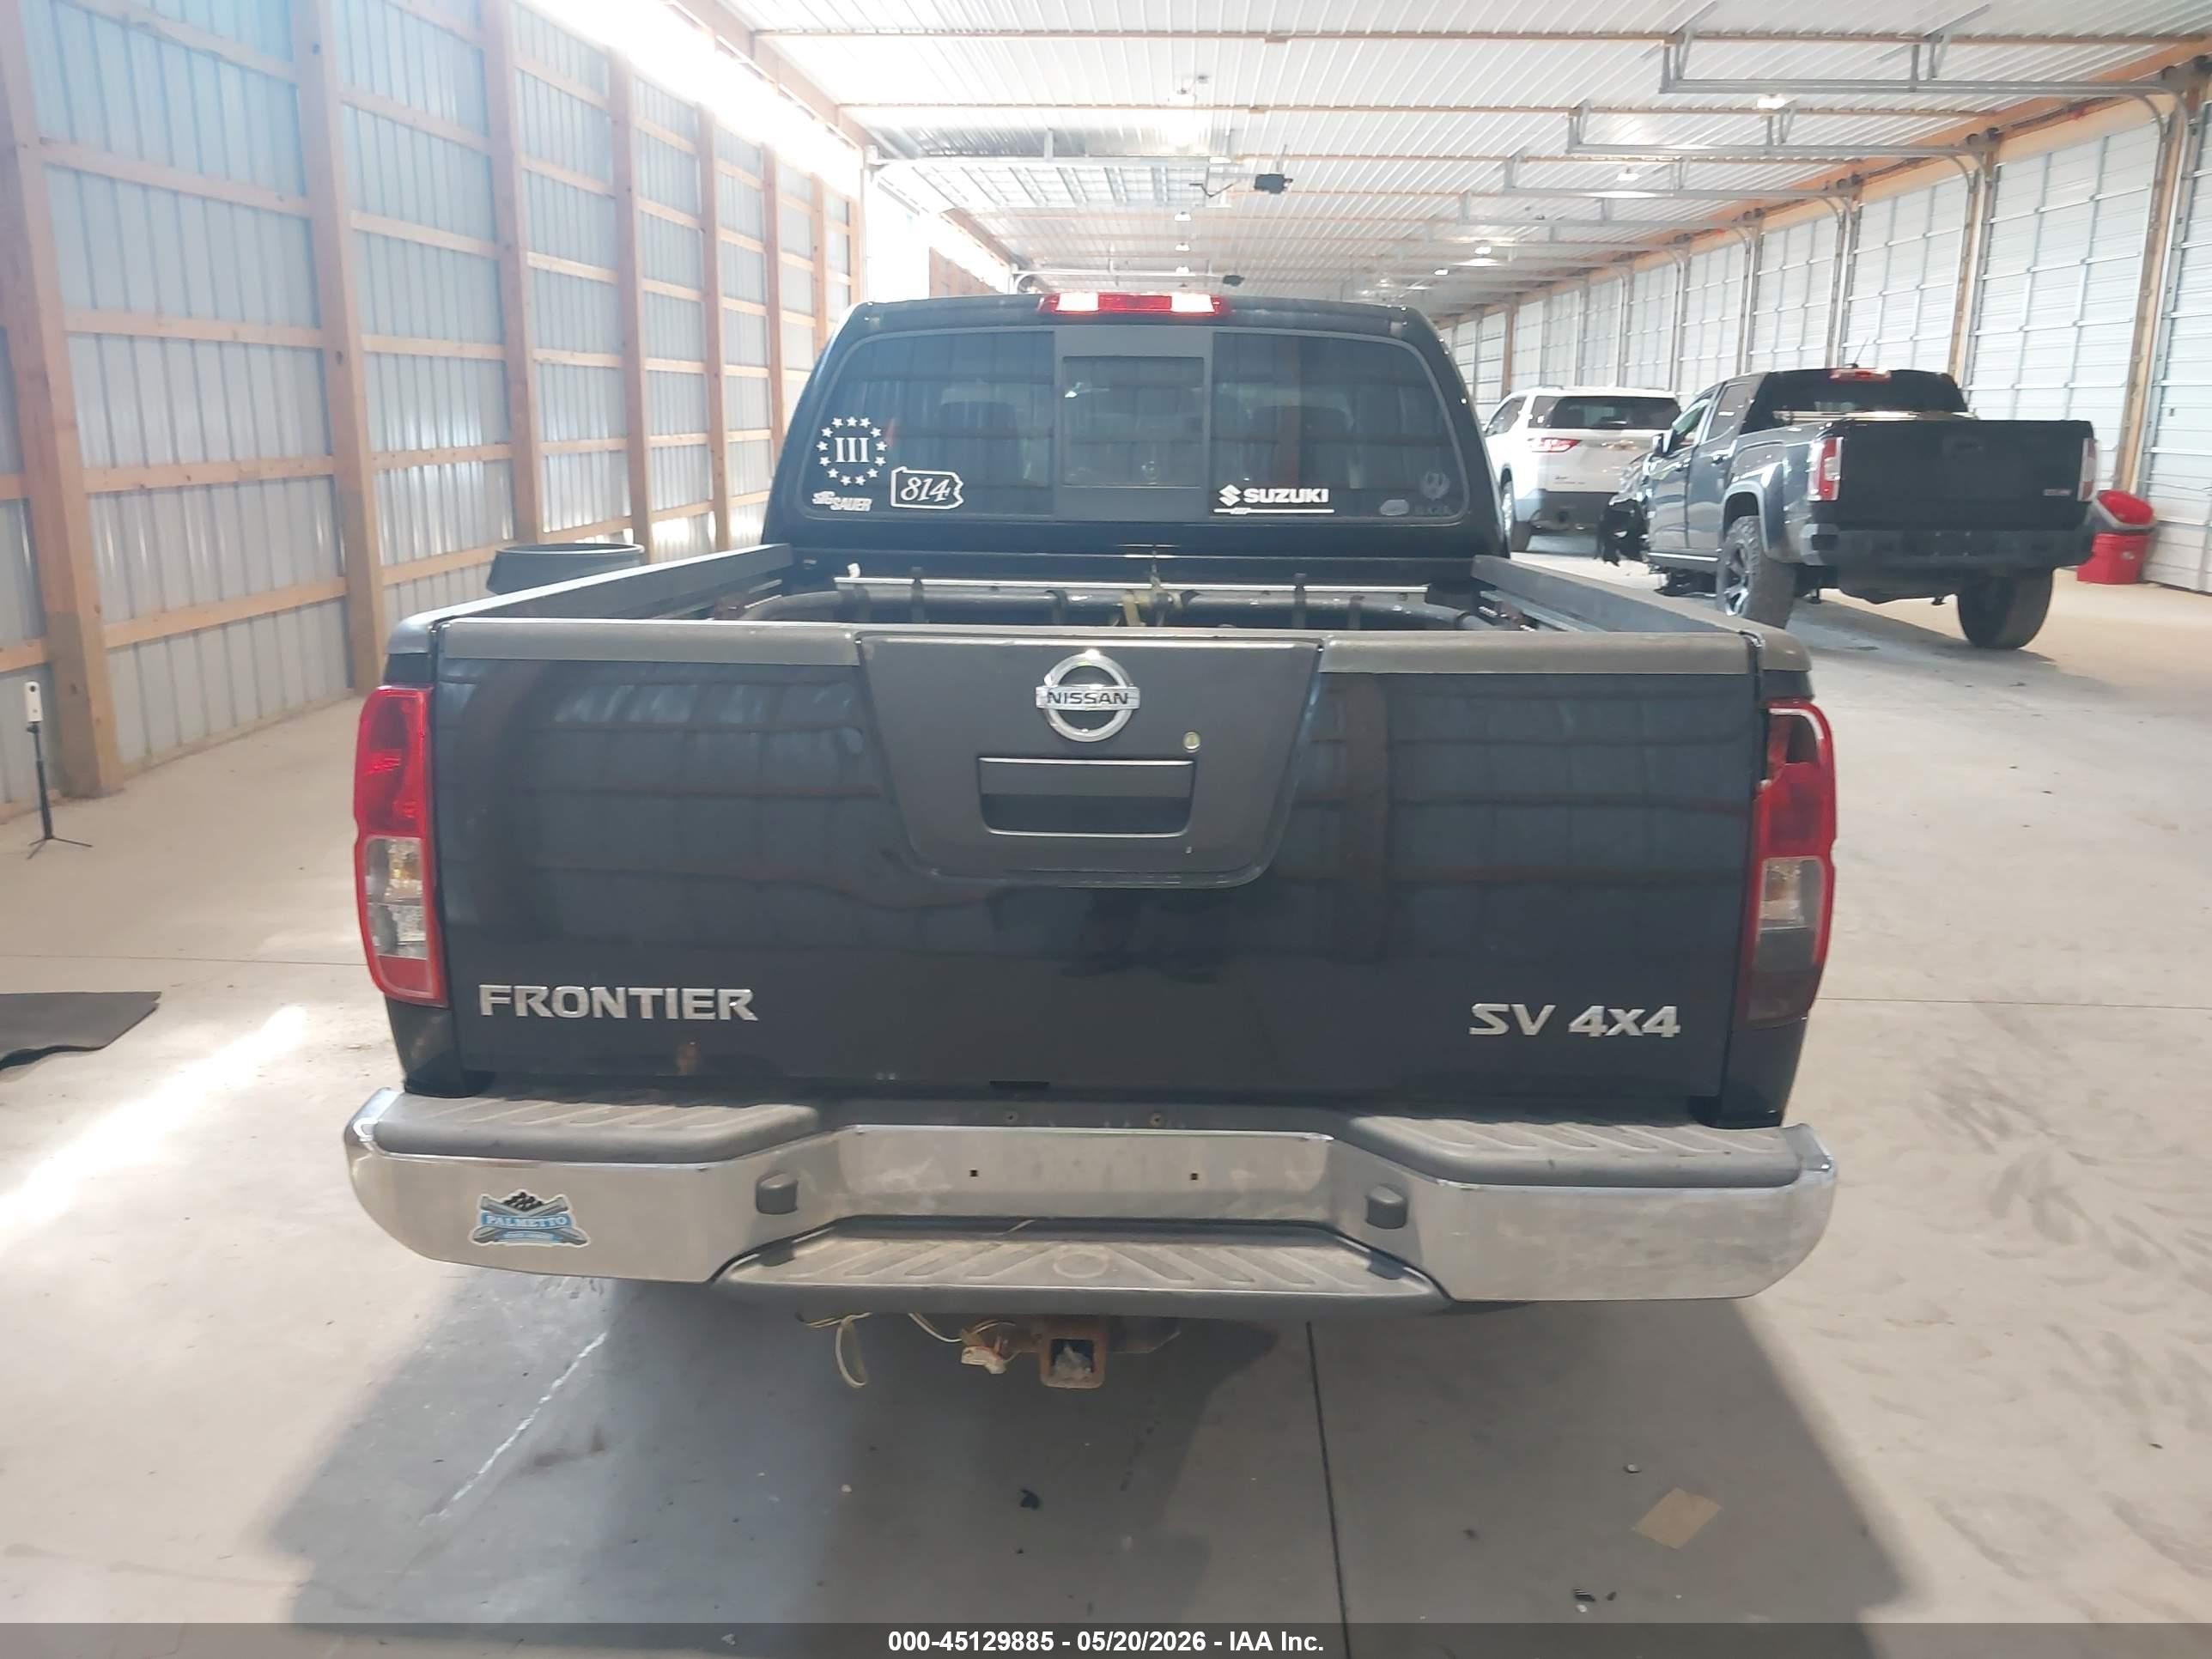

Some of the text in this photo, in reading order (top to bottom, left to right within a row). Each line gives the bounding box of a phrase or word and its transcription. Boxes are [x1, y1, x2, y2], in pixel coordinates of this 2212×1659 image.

[834, 437, 870, 463] III
[900, 477, 951, 502] 814
[1244, 488, 1330, 503] SUZUKI
[1047, 691, 1129, 705] NISSAN
[478, 984, 759, 1022] FRONTIER
[1469, 1003, 1556, 1036] SV
